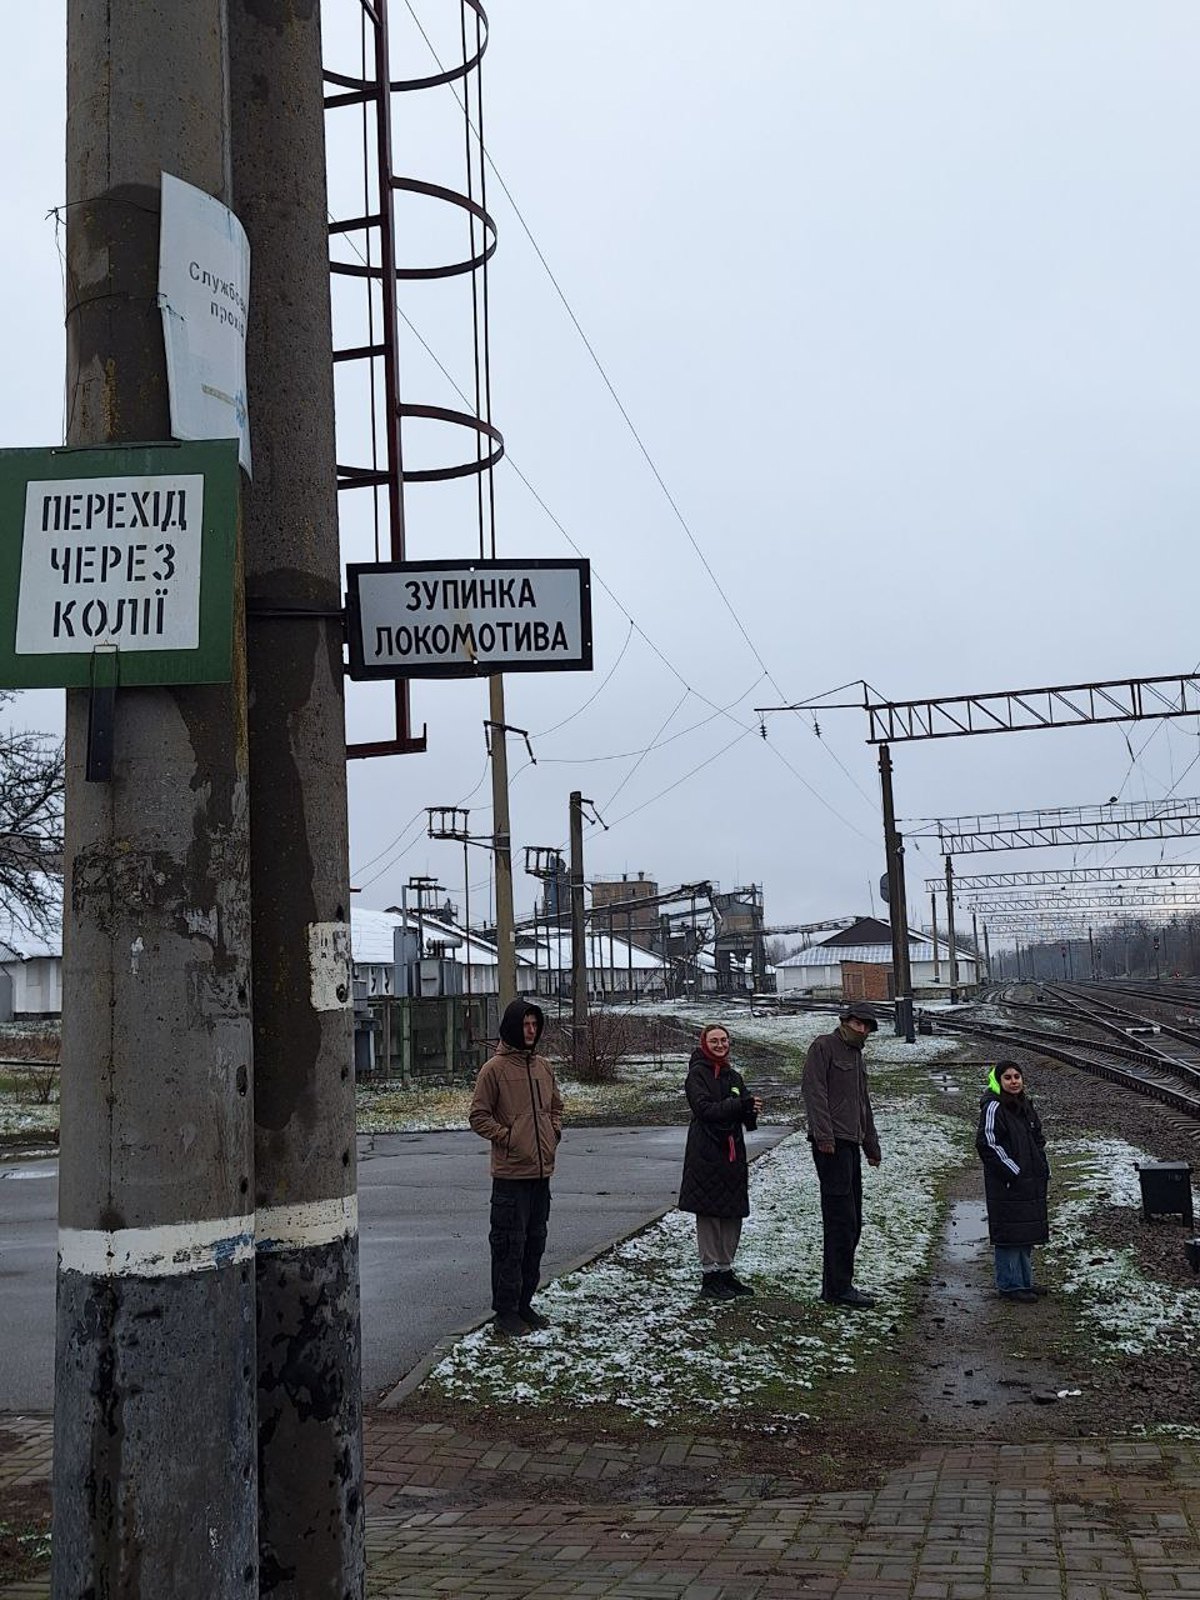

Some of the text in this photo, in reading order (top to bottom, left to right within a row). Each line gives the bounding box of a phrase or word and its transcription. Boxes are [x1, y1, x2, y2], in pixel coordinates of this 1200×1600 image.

[42, 490, 188, 532] ПЕРЕХІД
[50, 543, 176, 584] ЧЕРЕЗ
[53, 588, 168, 637] КОЛІЇ
[404, 578, 537, 611] ЗУПИНКА
[374, 621, 569, 657] ЛОКОМОТИВА
